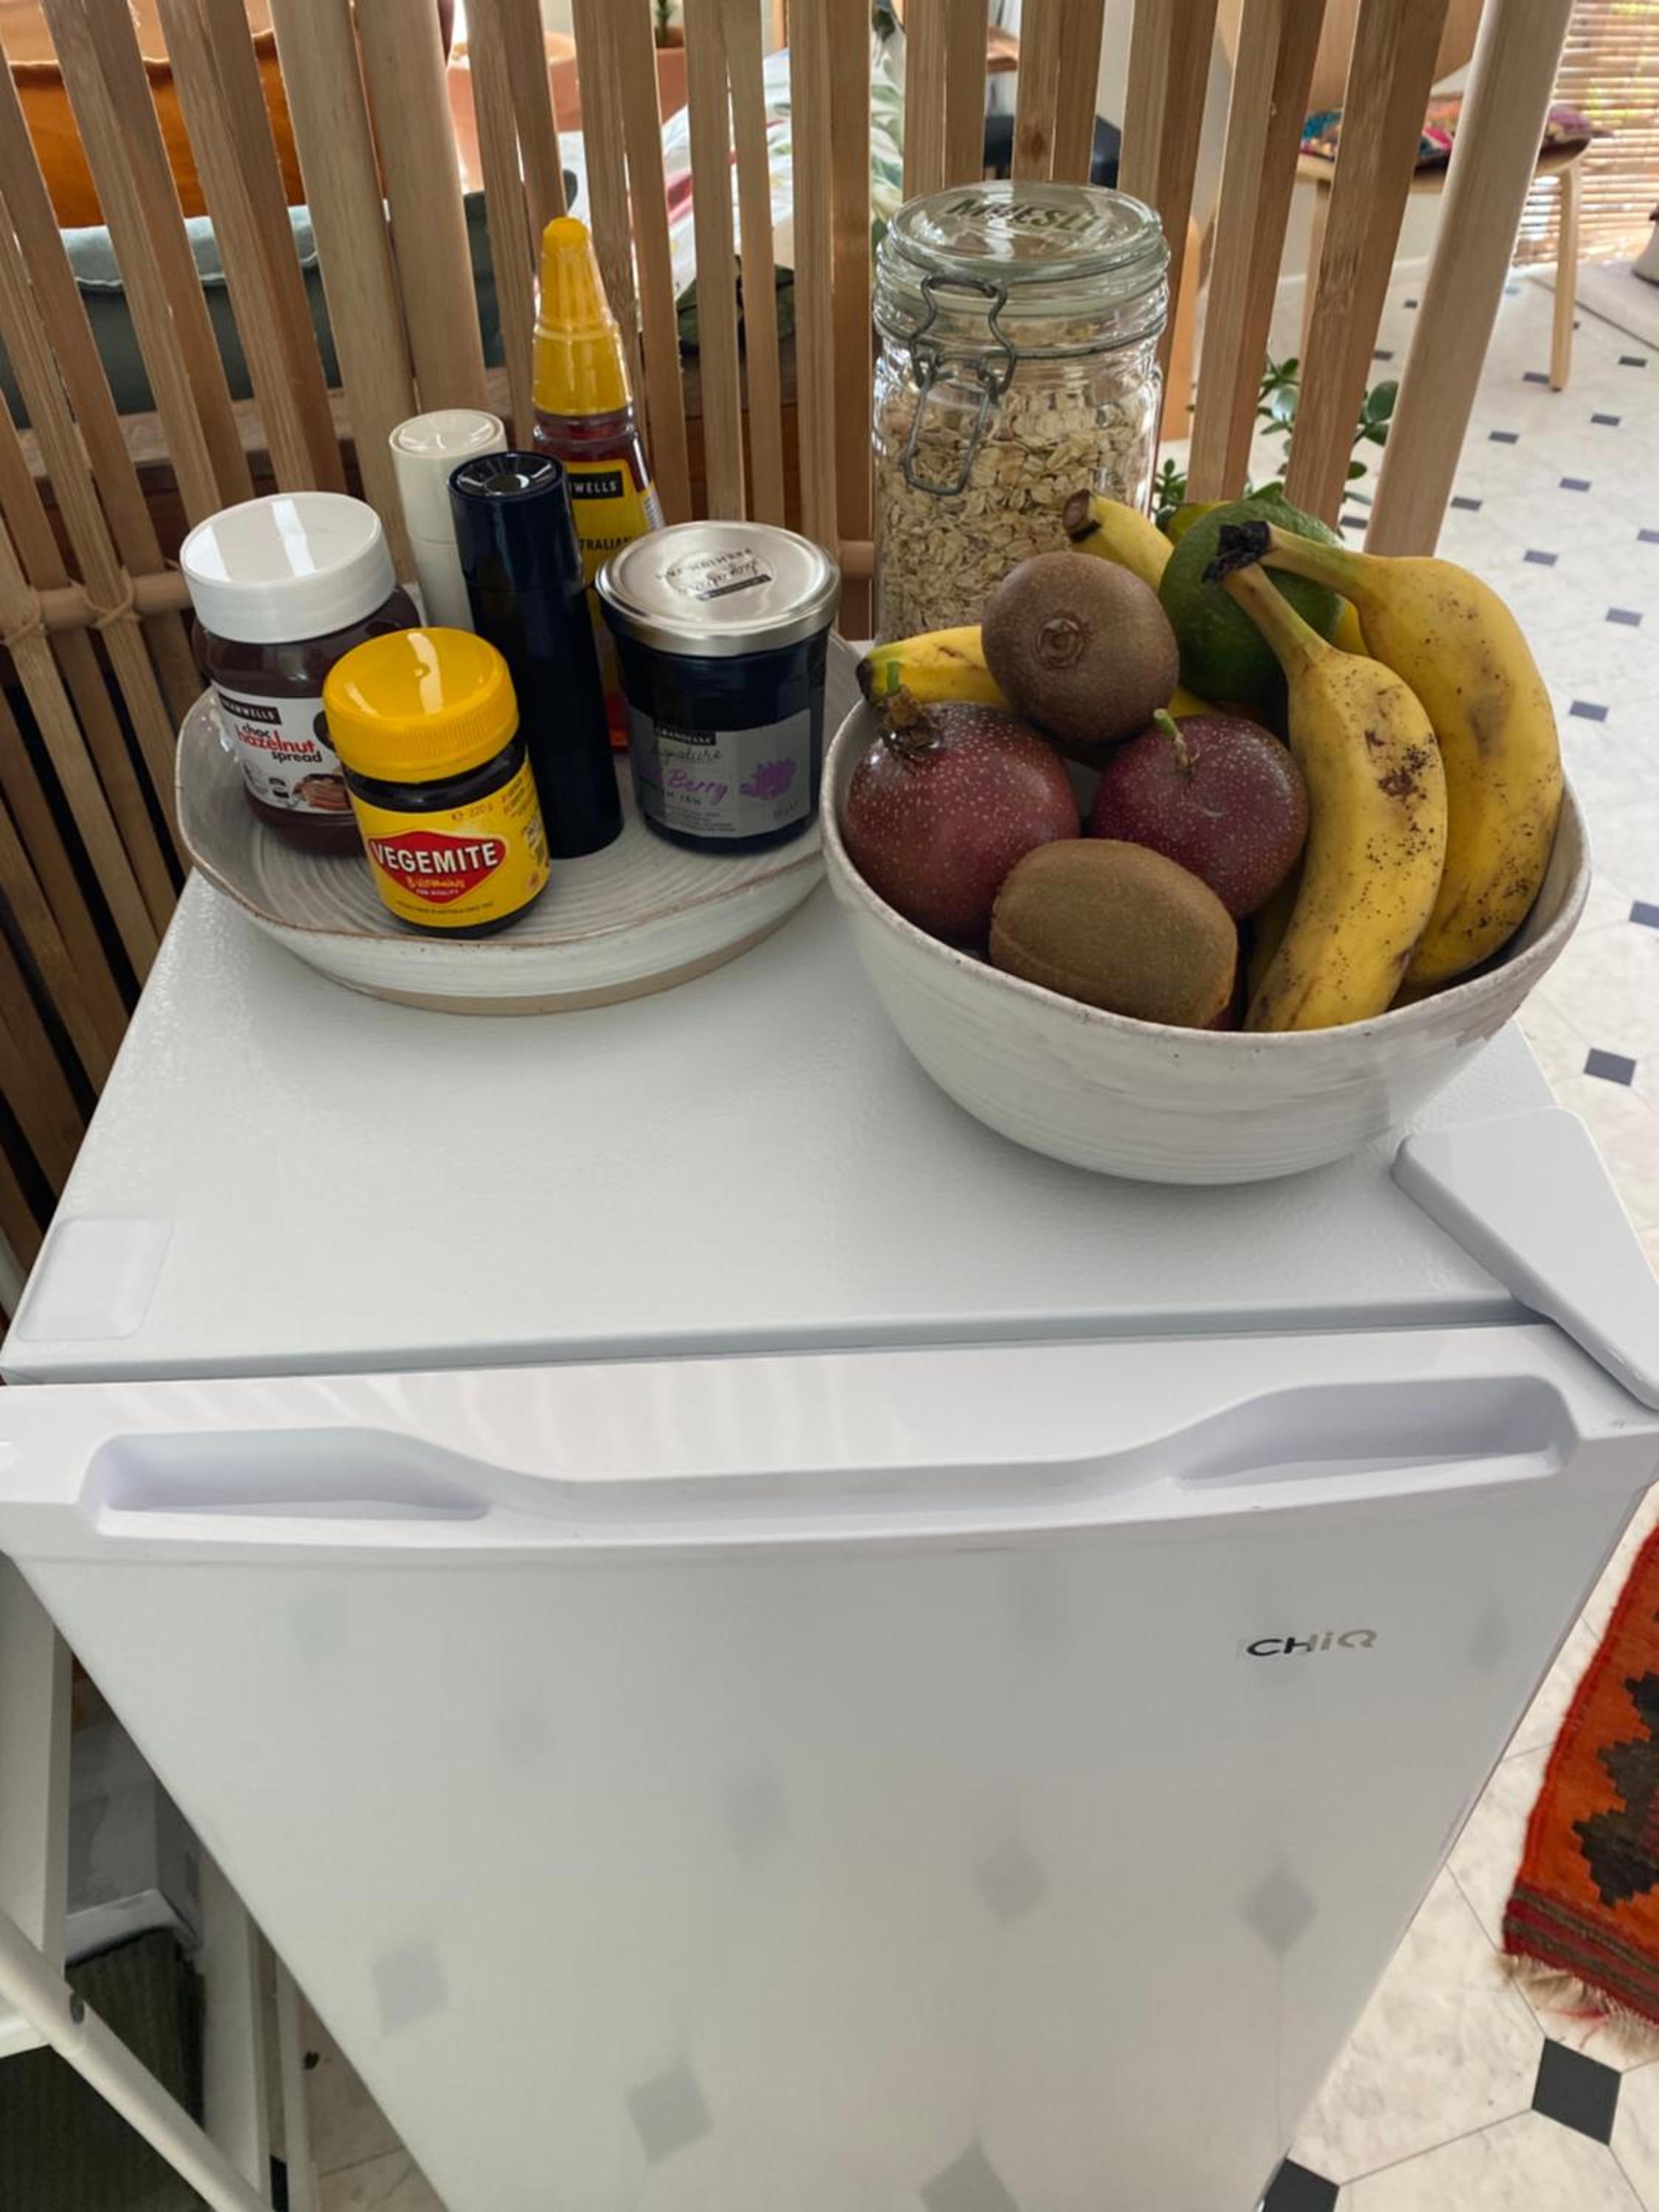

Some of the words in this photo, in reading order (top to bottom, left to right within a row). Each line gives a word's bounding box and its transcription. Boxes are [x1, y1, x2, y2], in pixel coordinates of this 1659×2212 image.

[568, 480, 617, 494] WELLS
[234, 724, 315, 754] hazelnut
[242, 723, 271, 737] choc
[271, 751, 322, 763] spread
[668, 768, 728, 803] Berry
[370, 841, 498, 874] VEGEMITE
